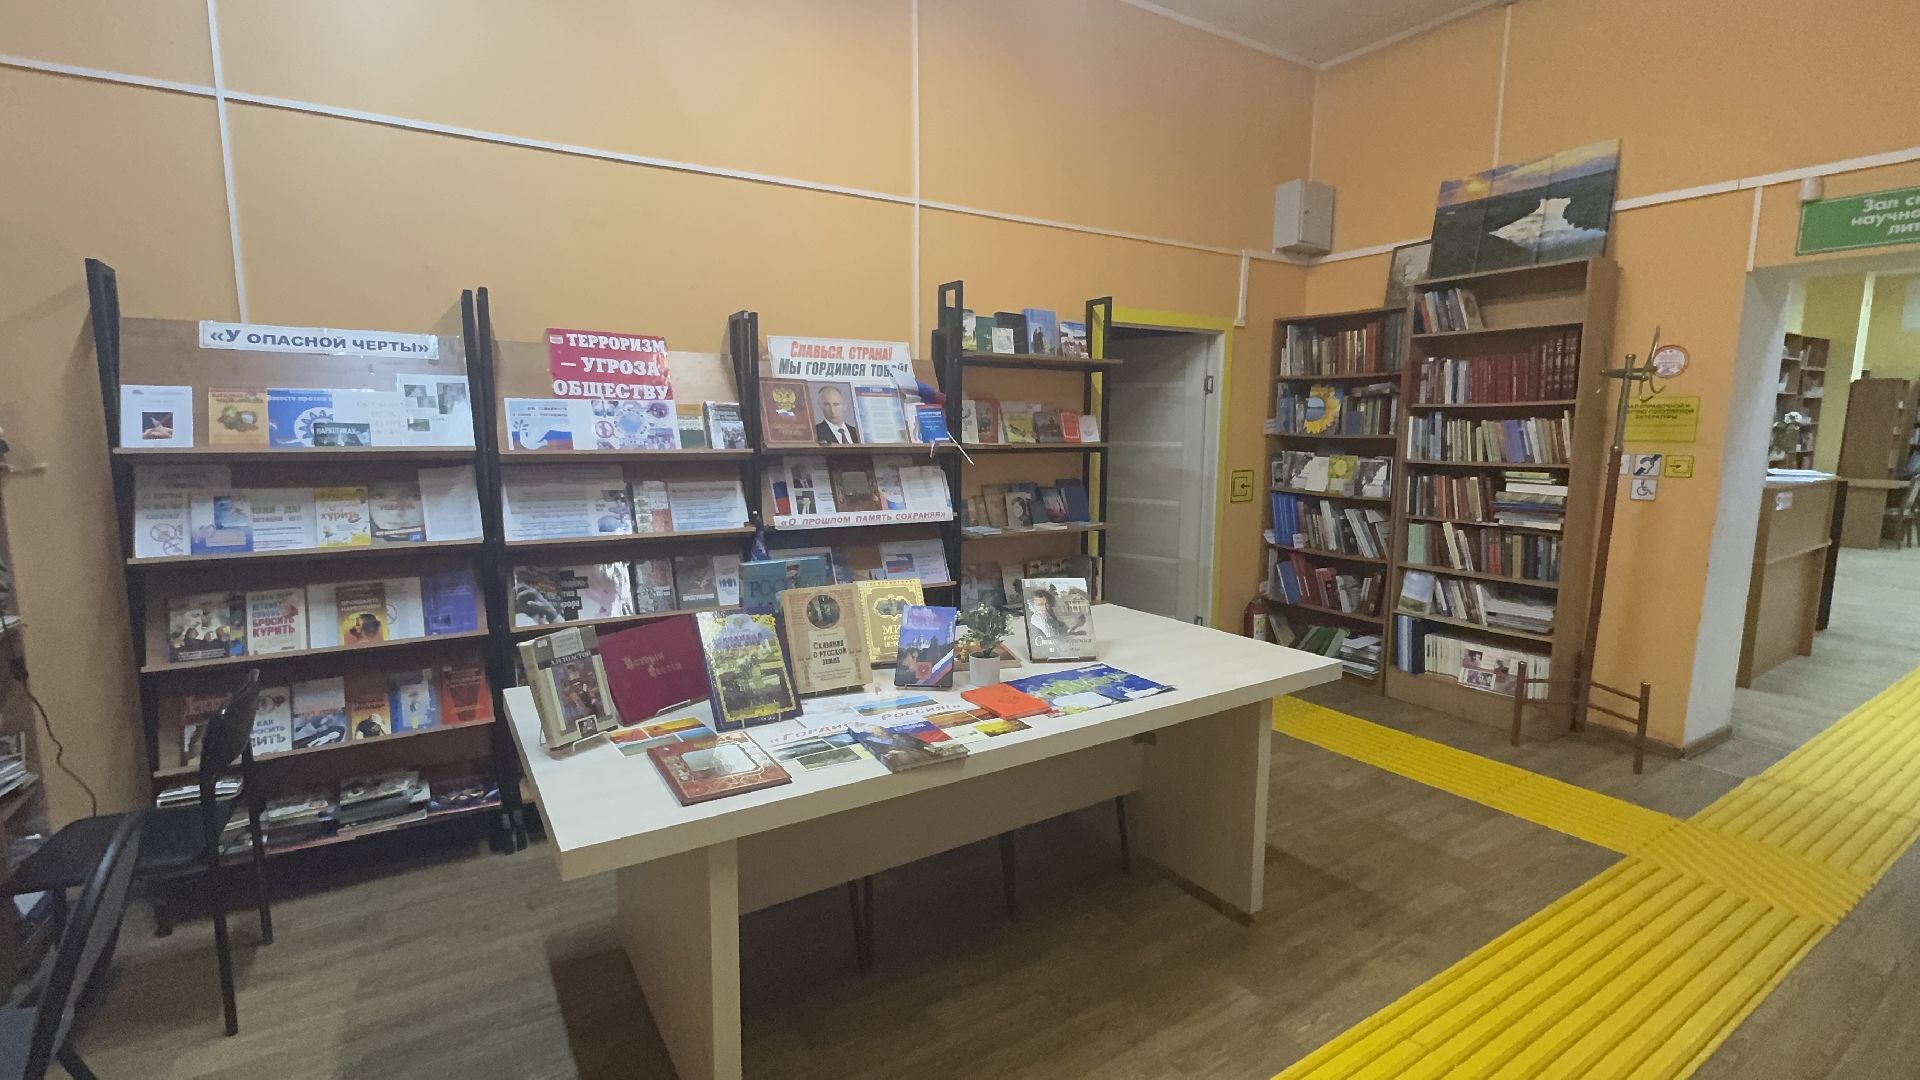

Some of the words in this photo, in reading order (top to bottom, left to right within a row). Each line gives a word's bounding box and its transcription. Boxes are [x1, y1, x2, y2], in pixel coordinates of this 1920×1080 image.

[210, 329, 241, 343] «У
[246, 333, 347, 349] ОПАСНОЙ
[352, 339, 429, 353] ЧЕРТЫ»
[566, 333, 666, 353] ТЕРРОРИЗМ
[581, 356, 661, 376] УГРОЗА
[805, 361, 866, 377] ГОРДИМСЯ
[553, 379, 669, 400] ОБЩЕСТВУ
[802, 516, 851, 526] ПРОШЛОМ
[856, 514, 892, 523] ПАМЯТЬ
[895, 511, 946, 520] СОХРАНЯЯ»
[252, 615, 295, 628] БРОСИТЬ
[252, 625, 295, 638] КУРИТЬ
[882, 624, 900, 635] МИ
[252, 726, 286, 736] РОСИТЬ
